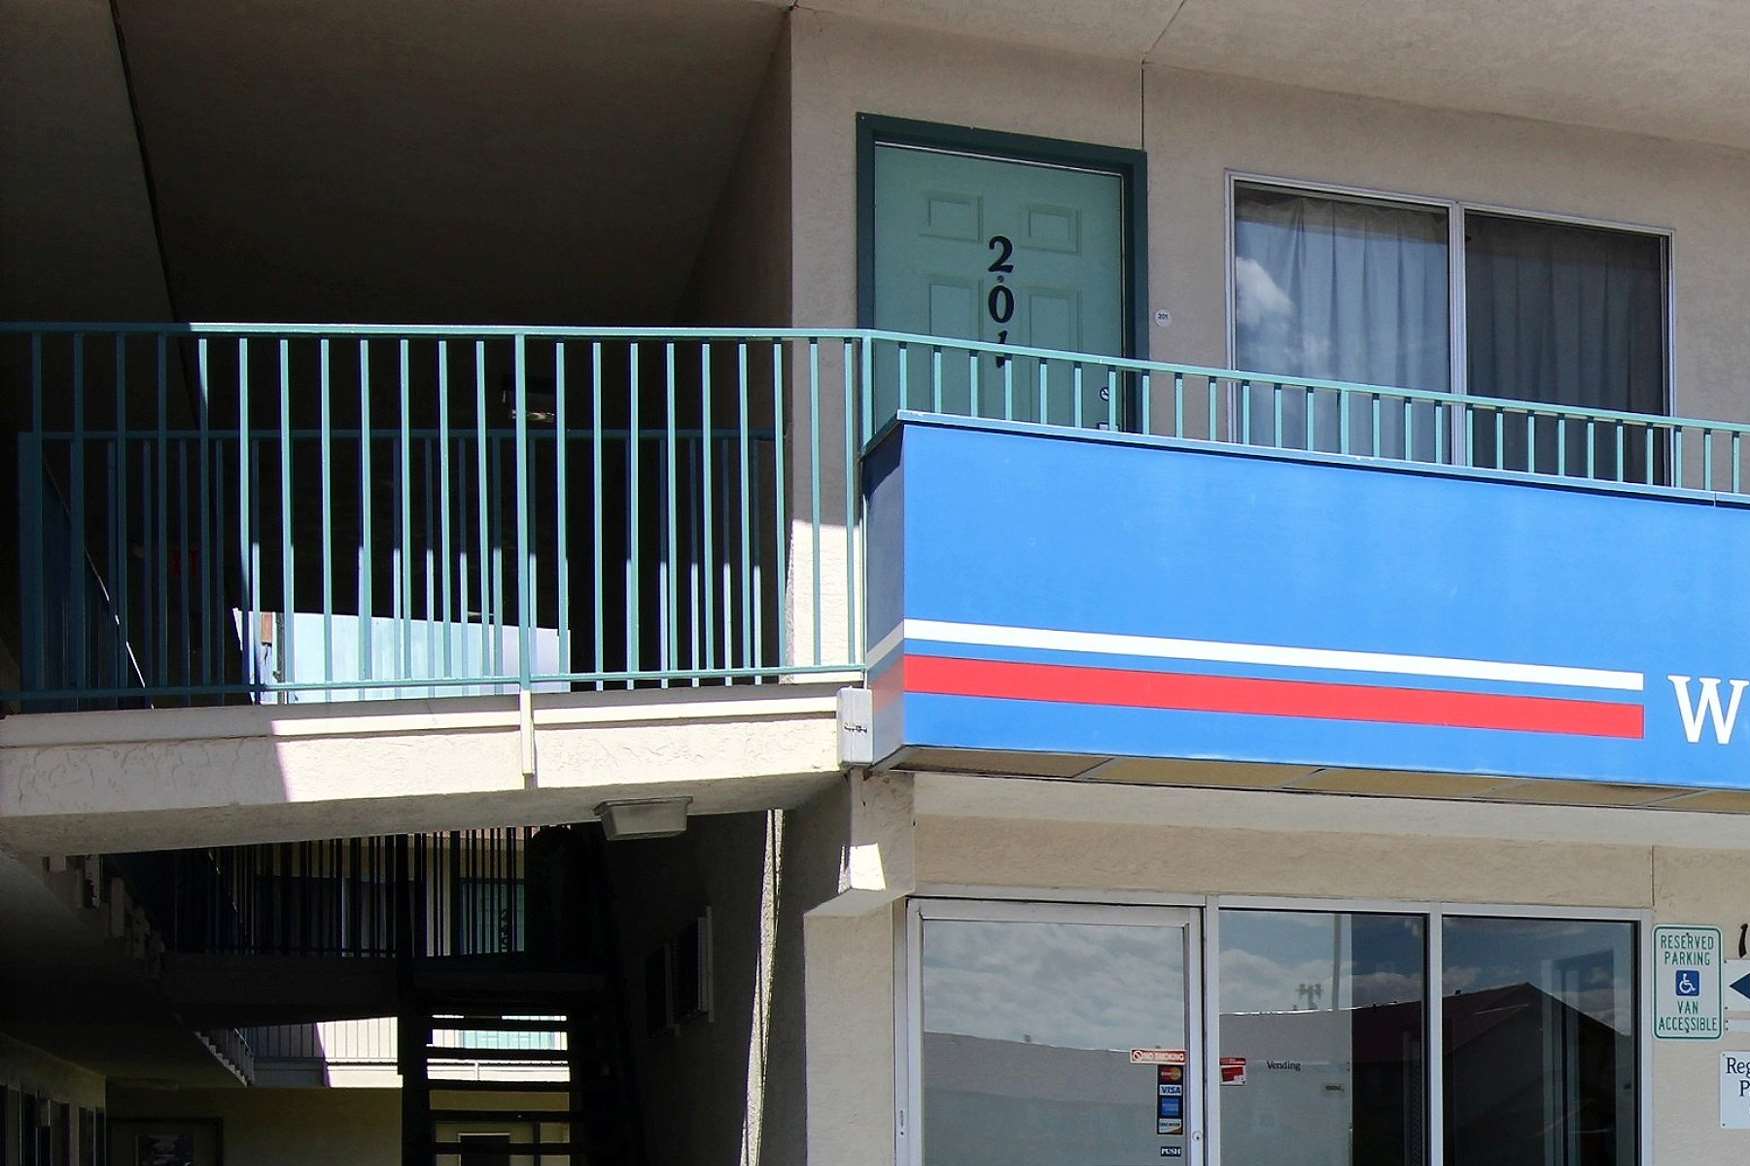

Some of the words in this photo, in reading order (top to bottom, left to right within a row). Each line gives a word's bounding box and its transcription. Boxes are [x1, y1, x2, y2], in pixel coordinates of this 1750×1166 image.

[1660, 935, 1714, 950] RESERVED
[1664, 951, 1711, 966] PARKING
[1677, 1001, 1698, 1014] VAN
[1658, 1016, 1718, 1032] ACCESSIBLE
[1266, 1061, 1301, 1071] Vending
[1161, 1086, 1180, 1094] VISA
[1161, 1147, 1181, 1155] PUSH
